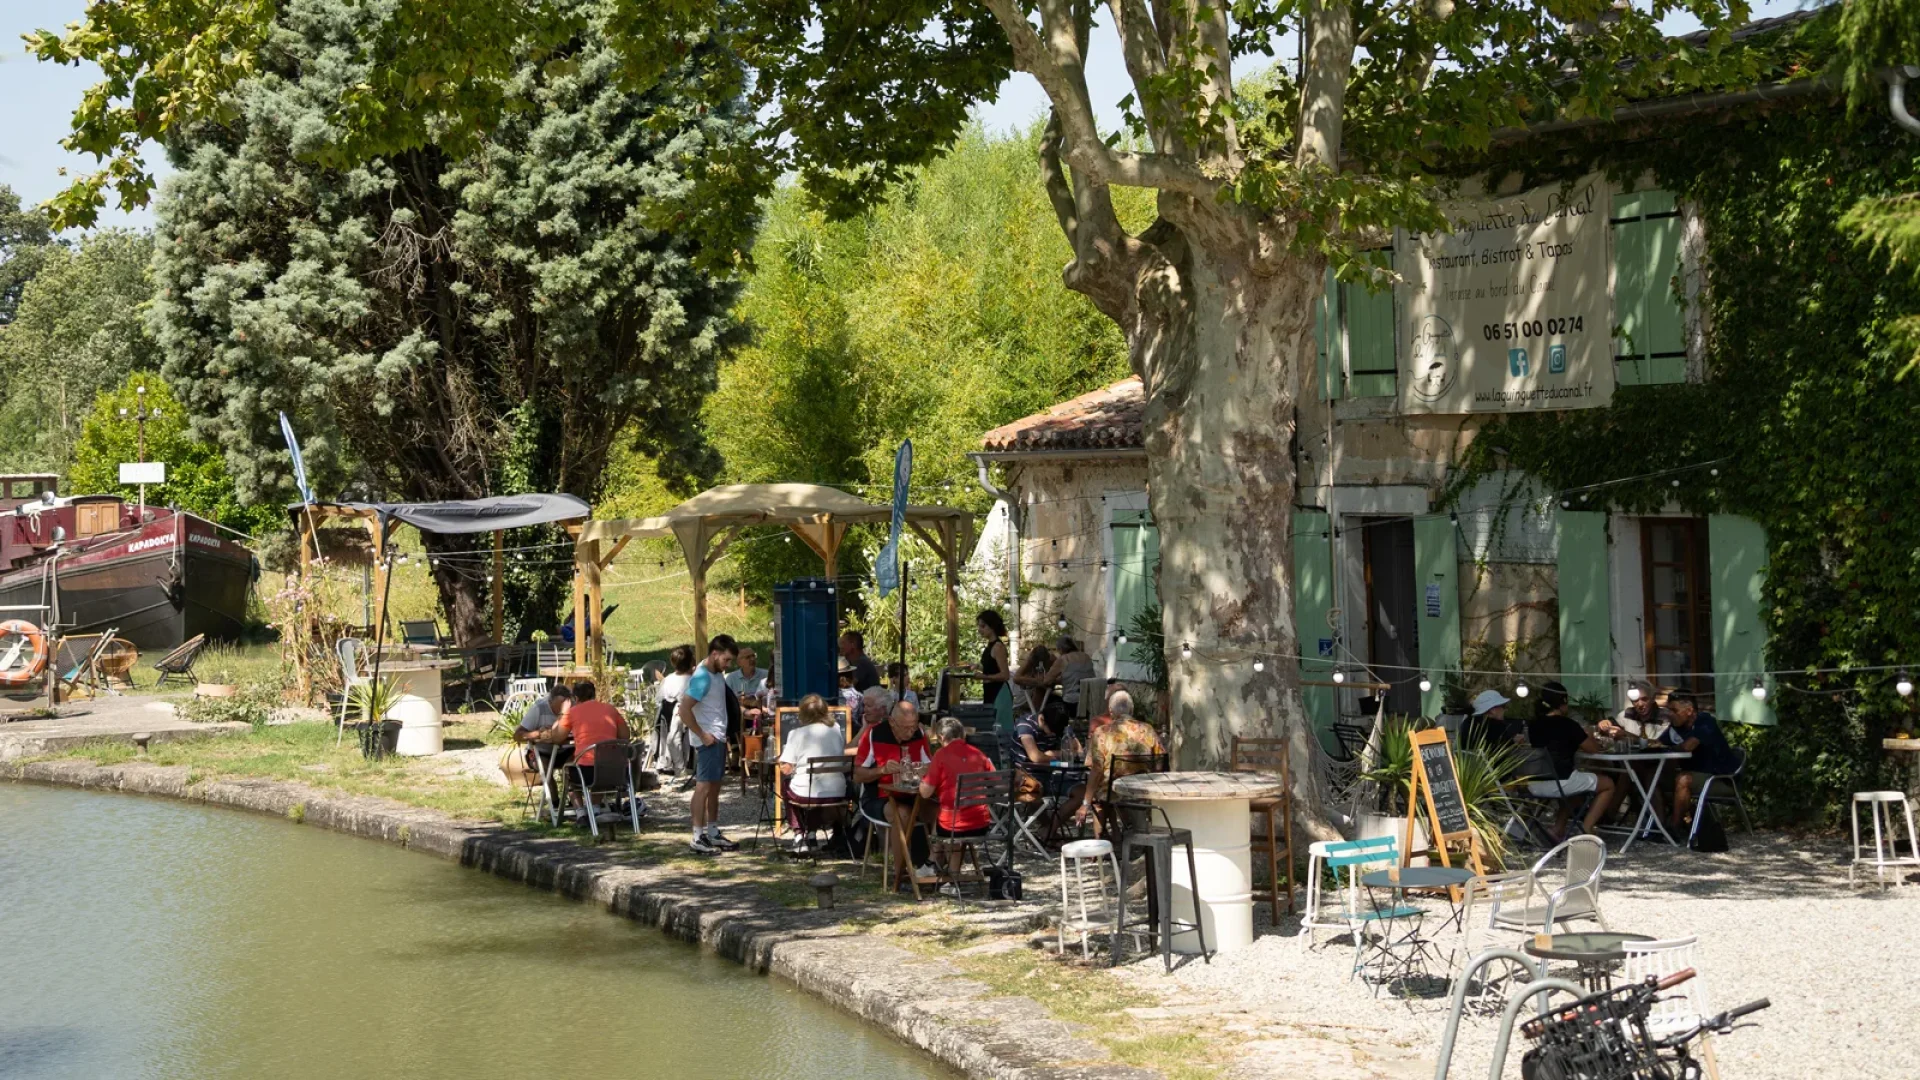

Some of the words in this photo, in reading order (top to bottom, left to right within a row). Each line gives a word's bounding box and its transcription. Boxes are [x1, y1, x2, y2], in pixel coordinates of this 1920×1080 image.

[1521, 201, 1540, 224] du
[1543, 185, 1595, 226] Canal
[1481, 244, 1521, 265] Bistrot
[1525, 243, 1534, 260] &
[1537, 240, 1573, 264] Tapas
[1475, 288, 1485, 299] au
[1490, 276, 1508, 298] bord
[1512, 276, 1525, 296] du
[1529, 273, 1555, 294] Canal
[1483, 323, 1500, 341] 06
[1504, 322, 1519, 340] 51
[1522, 319, 1543, 338] 00
[1547, 317, 1566, 335] 02
[1568, 315, 1583, 334] 74
[1475, 382, 1592, 407] www.laguinguetteducanal.fr
[128, 533, 175, 553] KAPADOKYA
